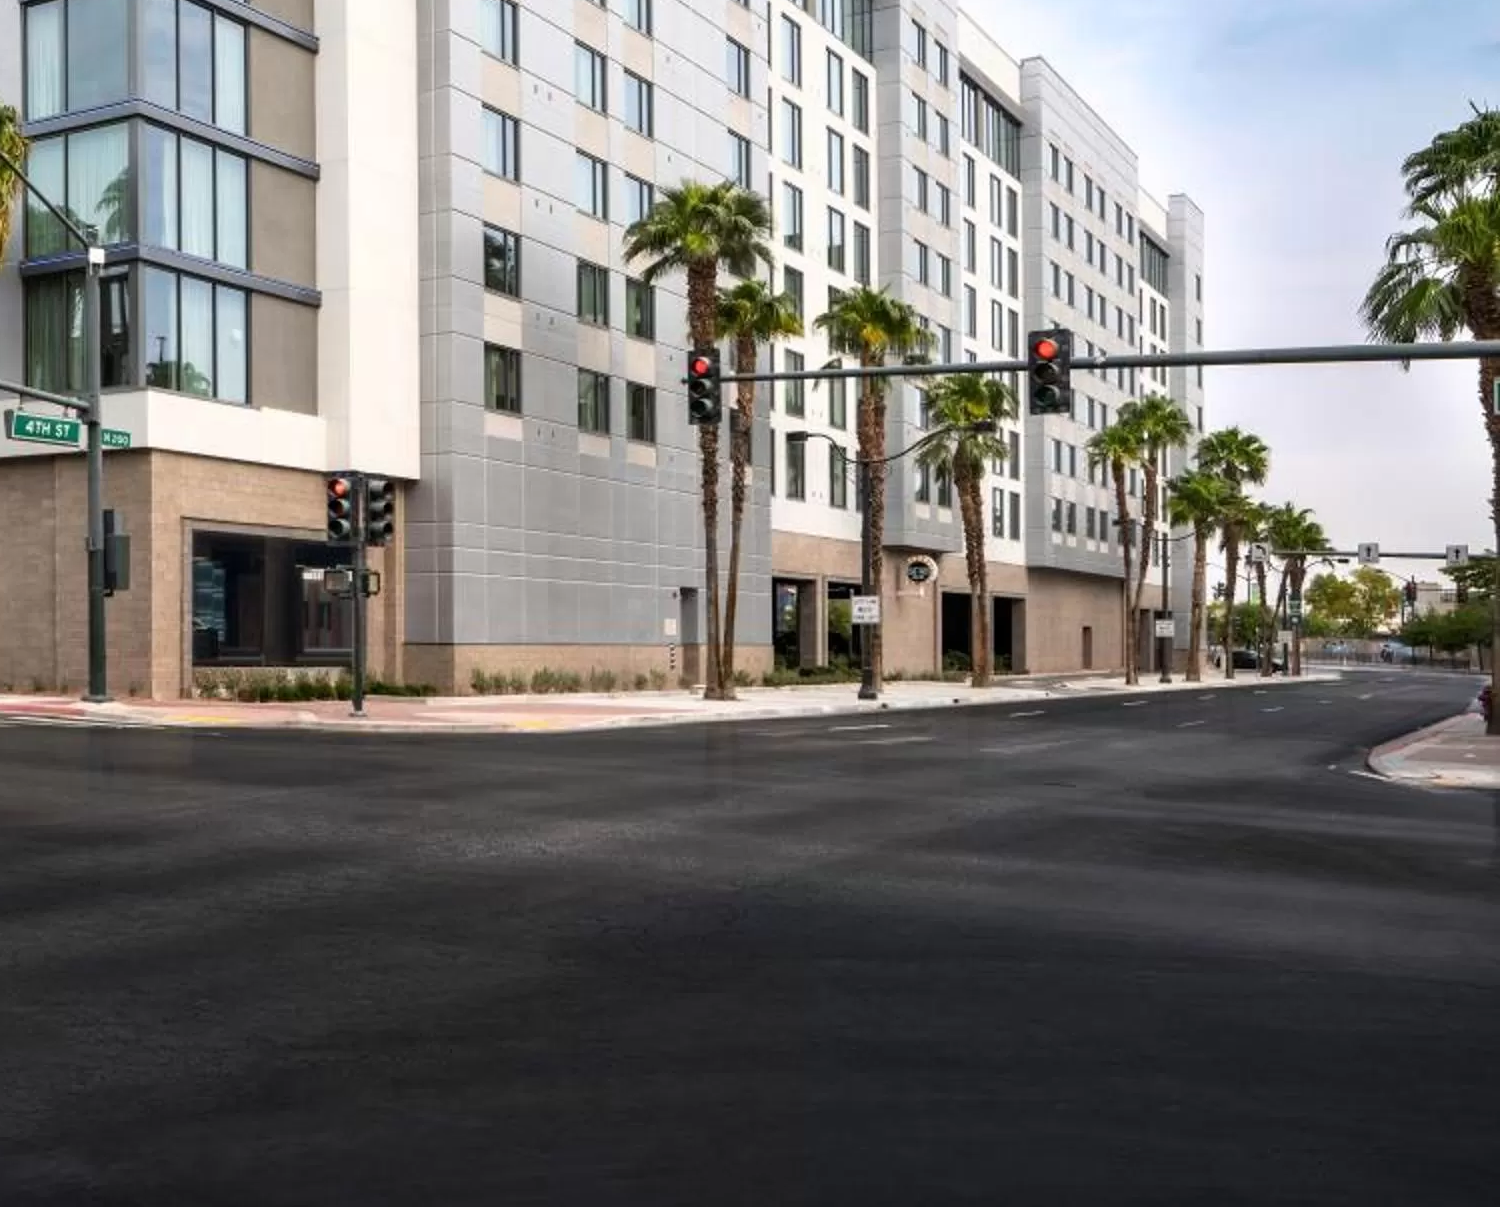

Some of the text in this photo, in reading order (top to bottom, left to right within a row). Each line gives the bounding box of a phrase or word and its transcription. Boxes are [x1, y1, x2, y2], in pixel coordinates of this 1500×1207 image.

[25, 420, 71, 439] 4TH ST
[103, 432, 111, 443] N
